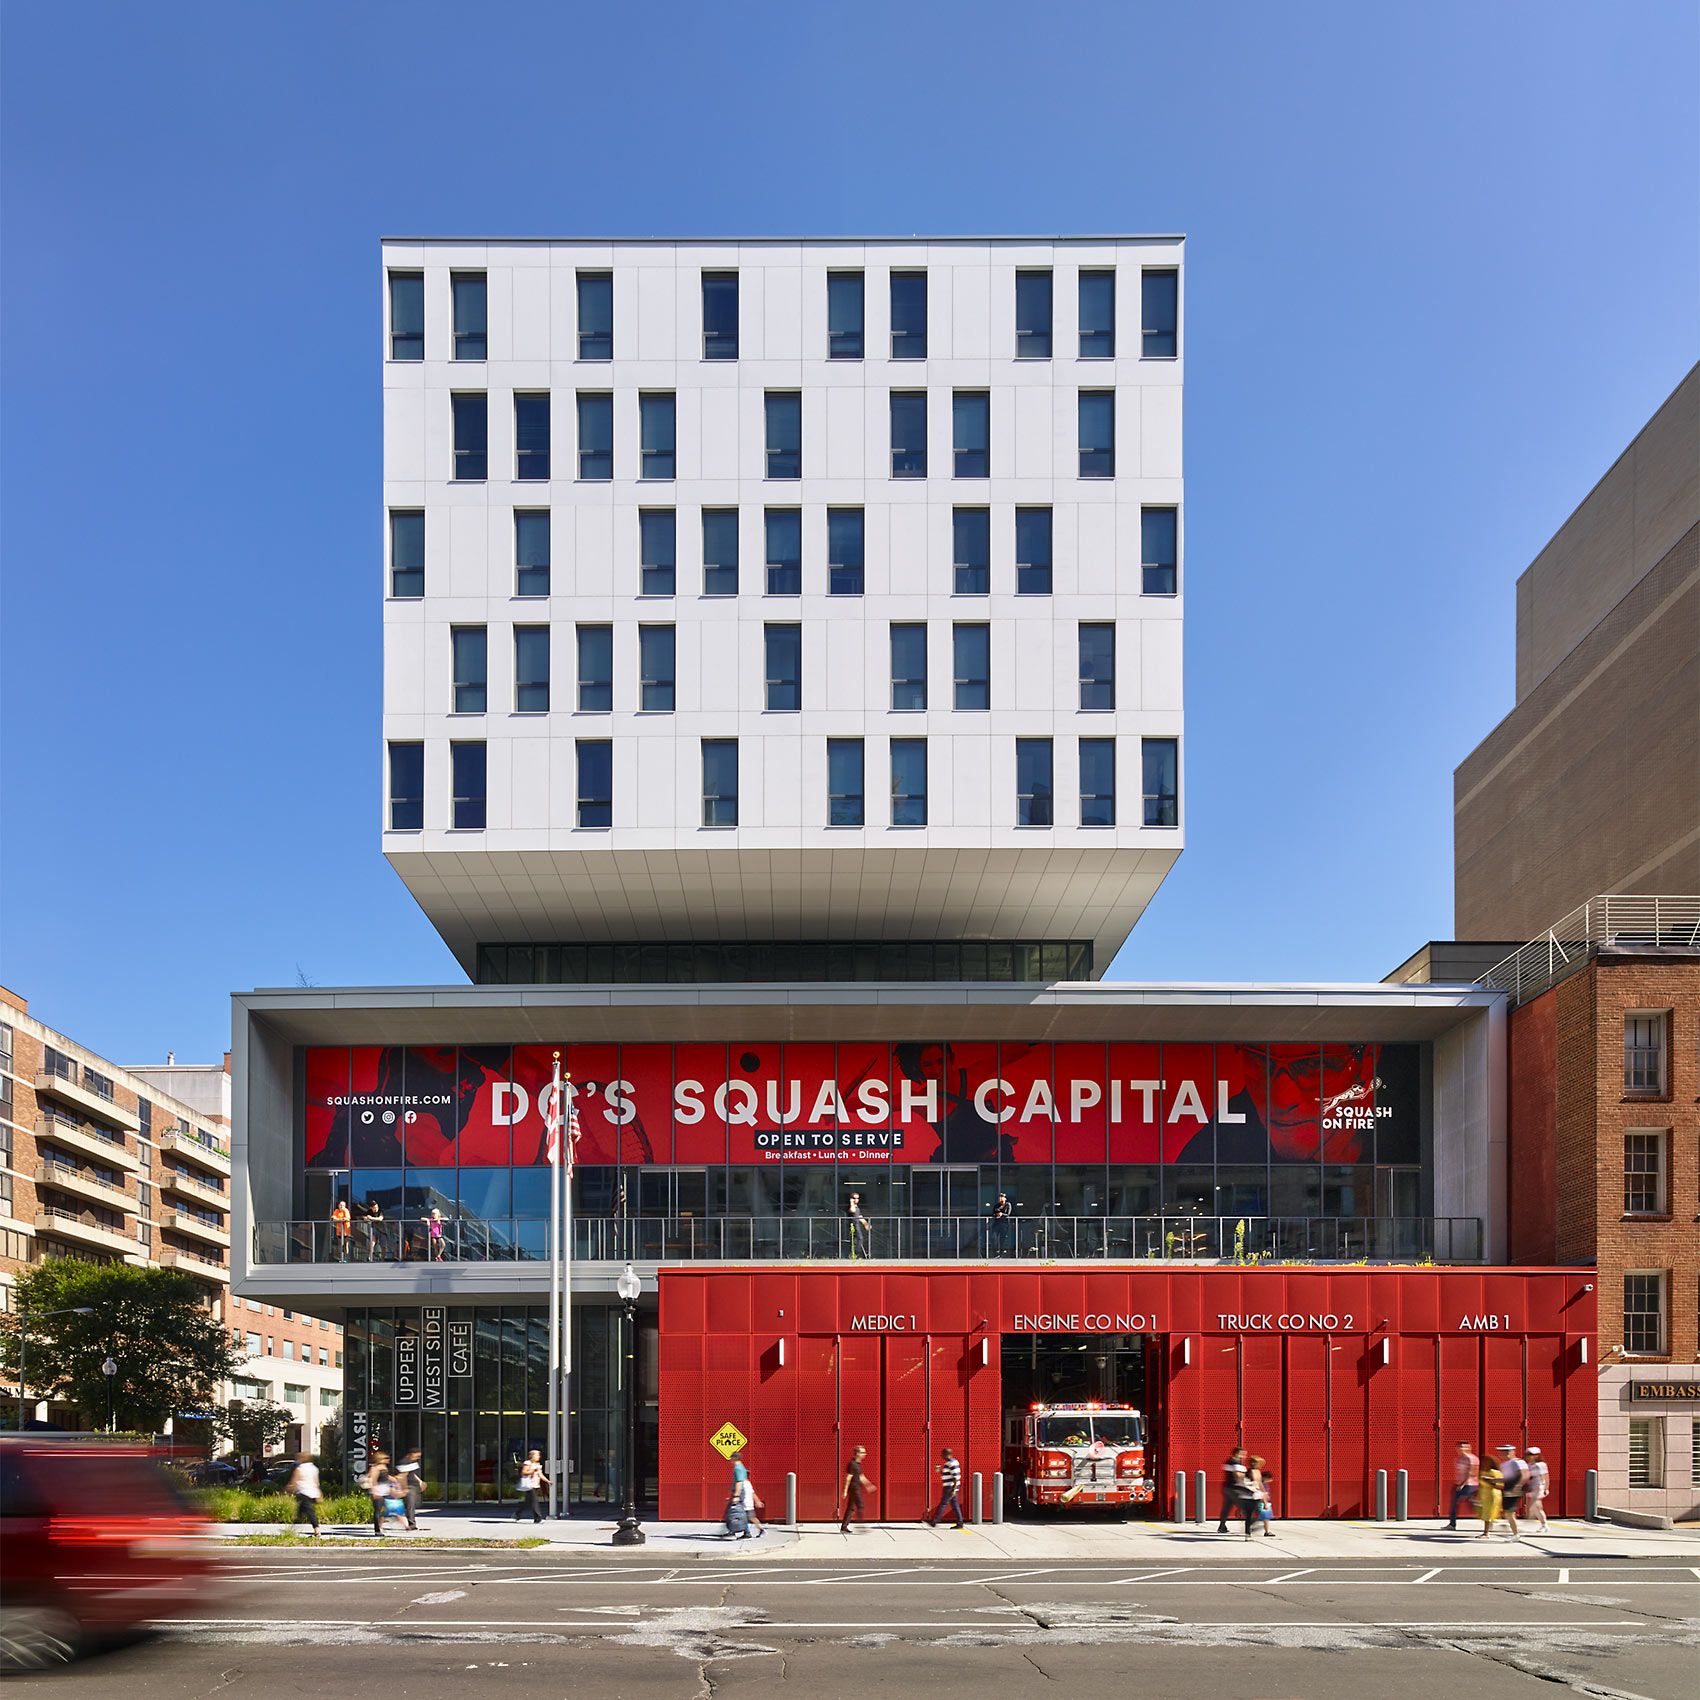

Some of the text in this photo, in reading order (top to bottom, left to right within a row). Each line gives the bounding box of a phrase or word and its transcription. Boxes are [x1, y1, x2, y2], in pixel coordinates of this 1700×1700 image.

[326, 1095, 451, 1106] SQUASHONFIRE.COM
[674, 1079, 938, 1126] SQUASH
[974, 1079, 1246, 1124] CAPITAL
[1335, 1106, 1393, 1118] SQUASH
[1322, 1118, 1375, 1130] ON FIRE
[757, 1133, 902, 1146] OPEN TO SERVE
[765, 1151, 890, 1159] Breakfast Lunch Dinner
[851, 1314, 916, 1330] MEDIC 1
[1014, 1314, 1156, 1330] ENGINE CO NO 1
[1217, 1314, 1354, 1330] TRUCK CO NO 2
[1458, 1314, 1509, 1330] AMB 1
[426, 1309, 441, 1406] WEST SIDE
[450, 1325, 468, 1374] CAFÉ
[399, 1339, 415, 1400] UPPER
